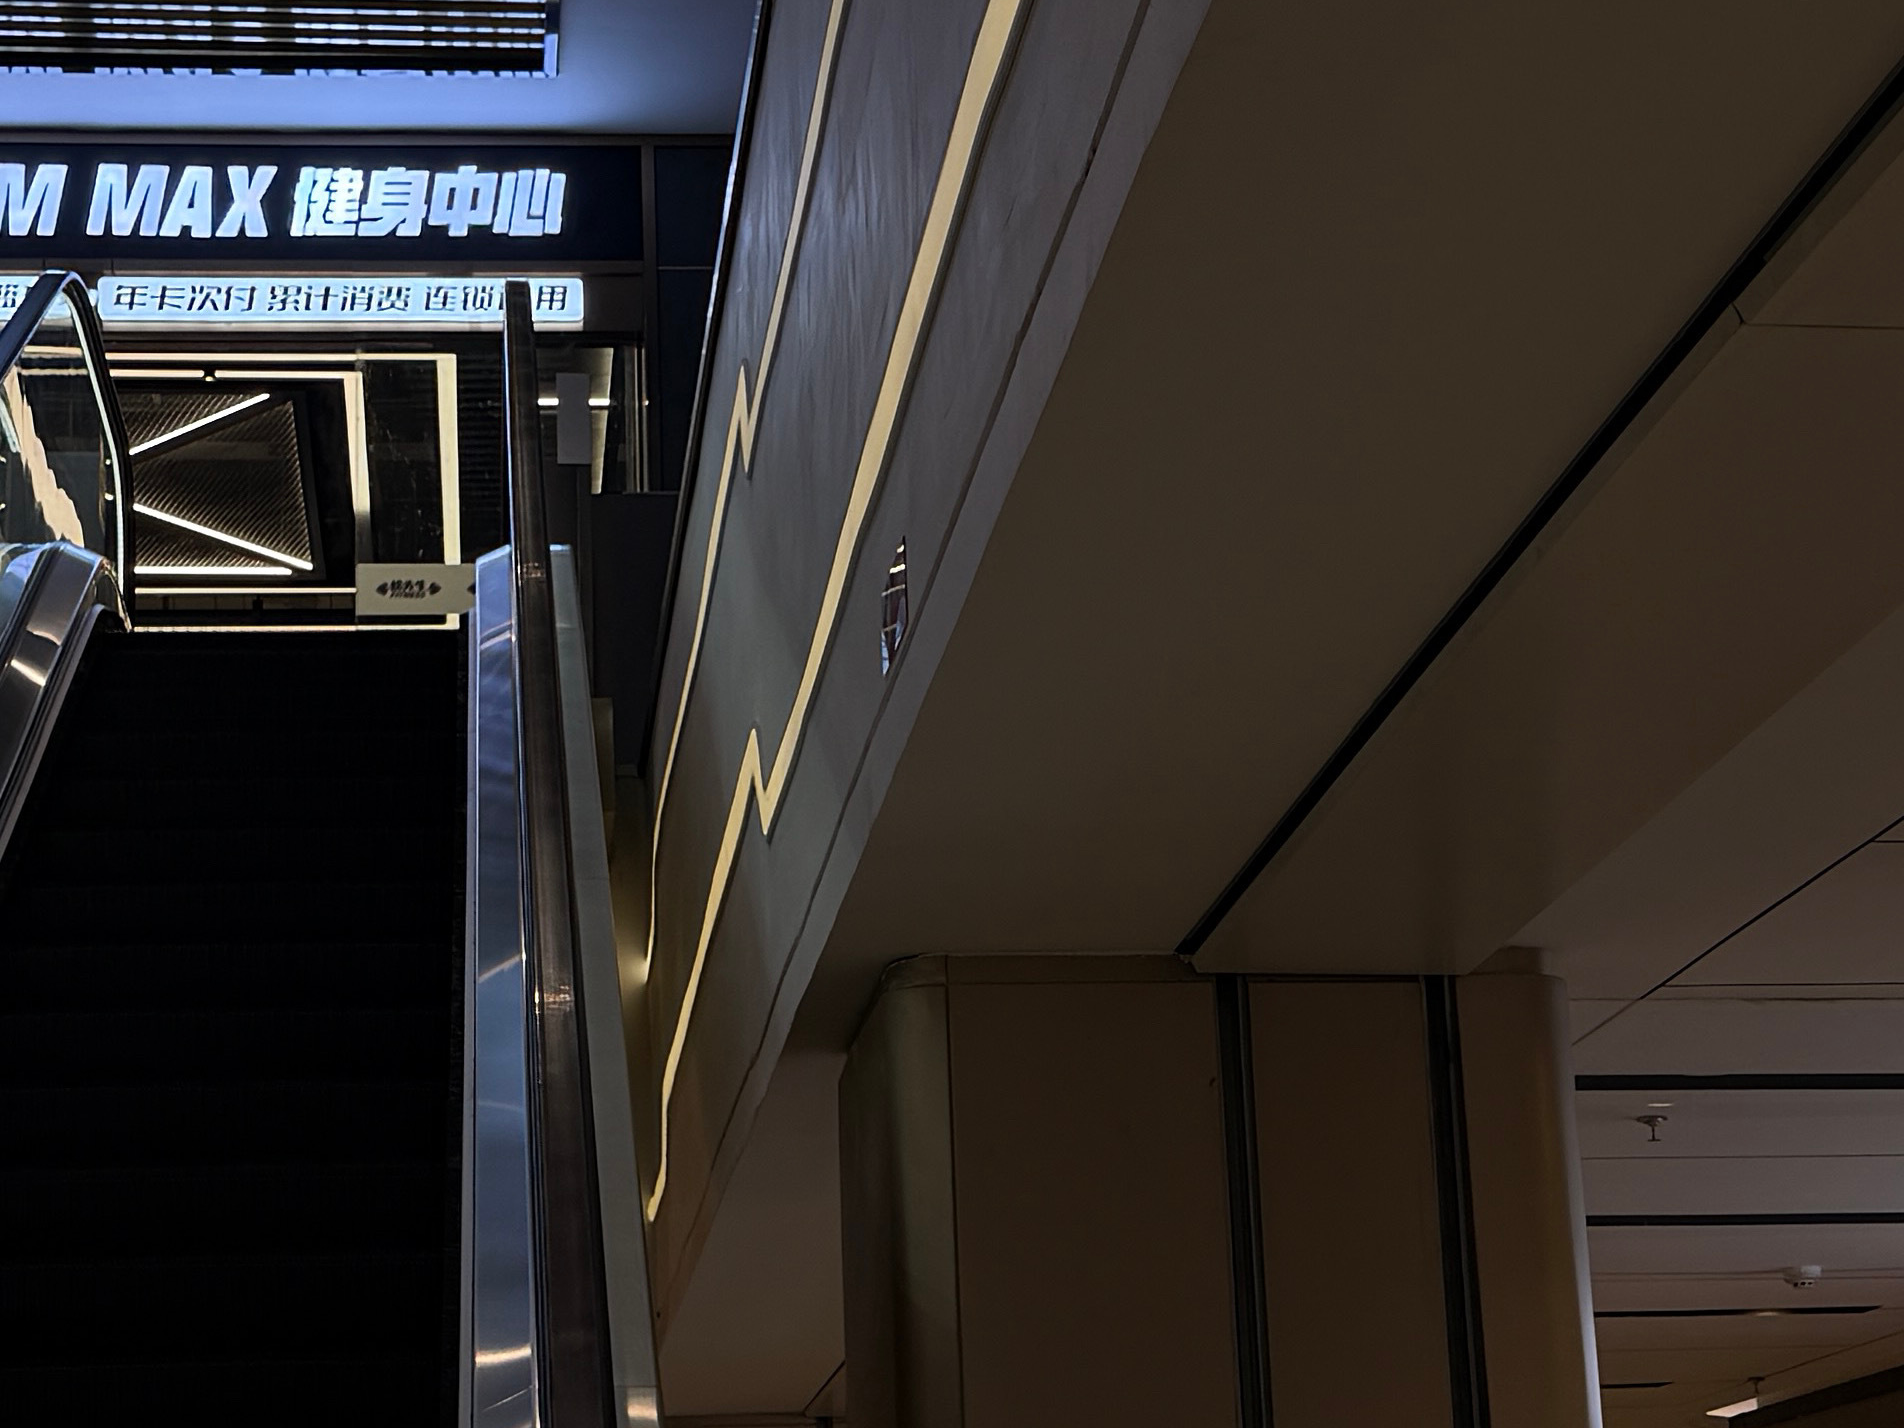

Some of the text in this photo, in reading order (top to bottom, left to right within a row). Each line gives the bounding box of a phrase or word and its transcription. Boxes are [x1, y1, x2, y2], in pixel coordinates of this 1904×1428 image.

[86, 163, 277, 237] MAX
[290, 165, 566, 237] 健身中心
[113, 284, 255, 312] 年卡次付
[267, 283, 411, 312] 累计消费
[424, 283, 567, 312] 连锁用
